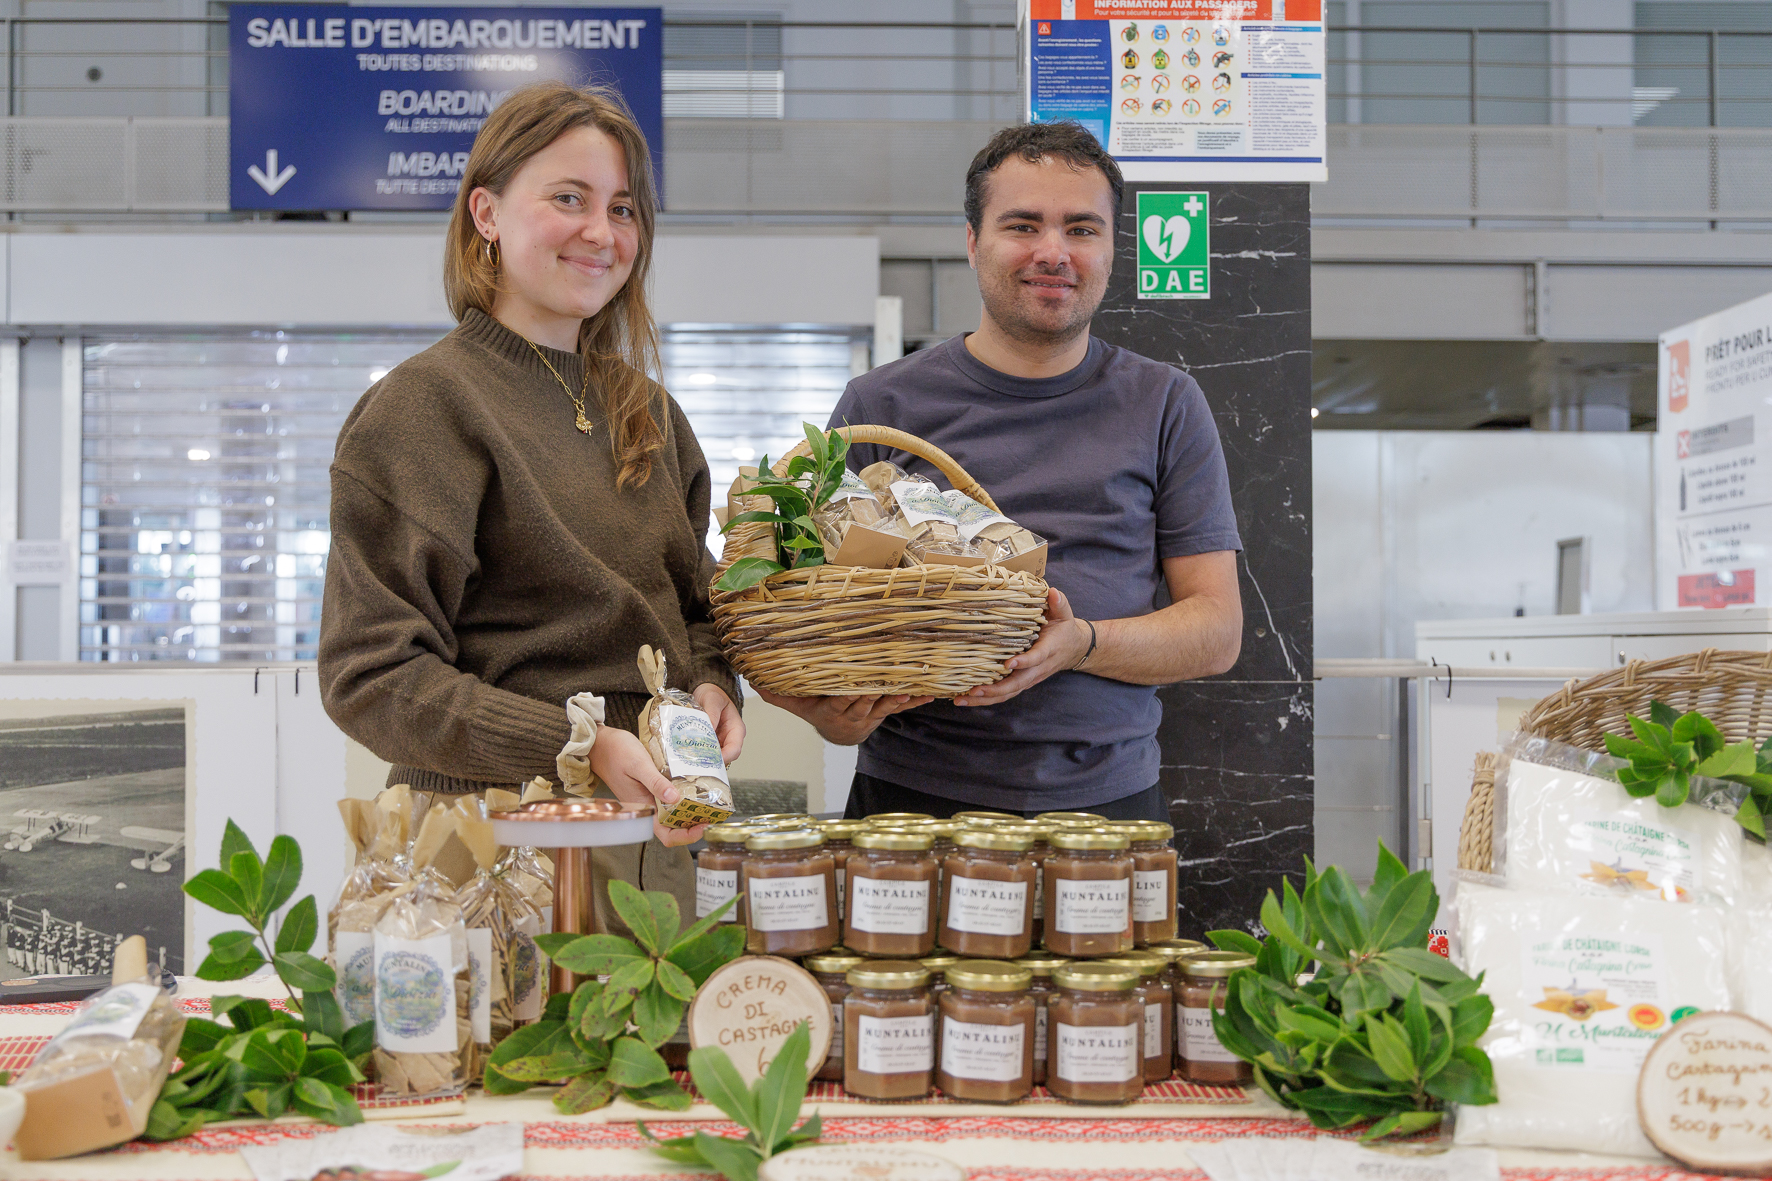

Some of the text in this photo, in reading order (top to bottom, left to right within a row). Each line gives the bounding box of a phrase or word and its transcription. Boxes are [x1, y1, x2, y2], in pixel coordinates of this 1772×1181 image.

[1094, 0, 1258, 9] INFORMATION AUX PASSAGERS
[247, 17, 646, 49] SALLE D'EMBARQUEMENT
[356, 53, 538, 72] TOUTES DESTINATIONS
[378, 89, 506, 116] BOARDIN
[387, 151, 471, 177] IMBAR
[1141, 270, 1204, 291] DAE
[716, 975, 787, 1009] CREMA
[744, 1001, 769, 1020] DI
[1666, 1061, 1772, 1086] Castagnin
